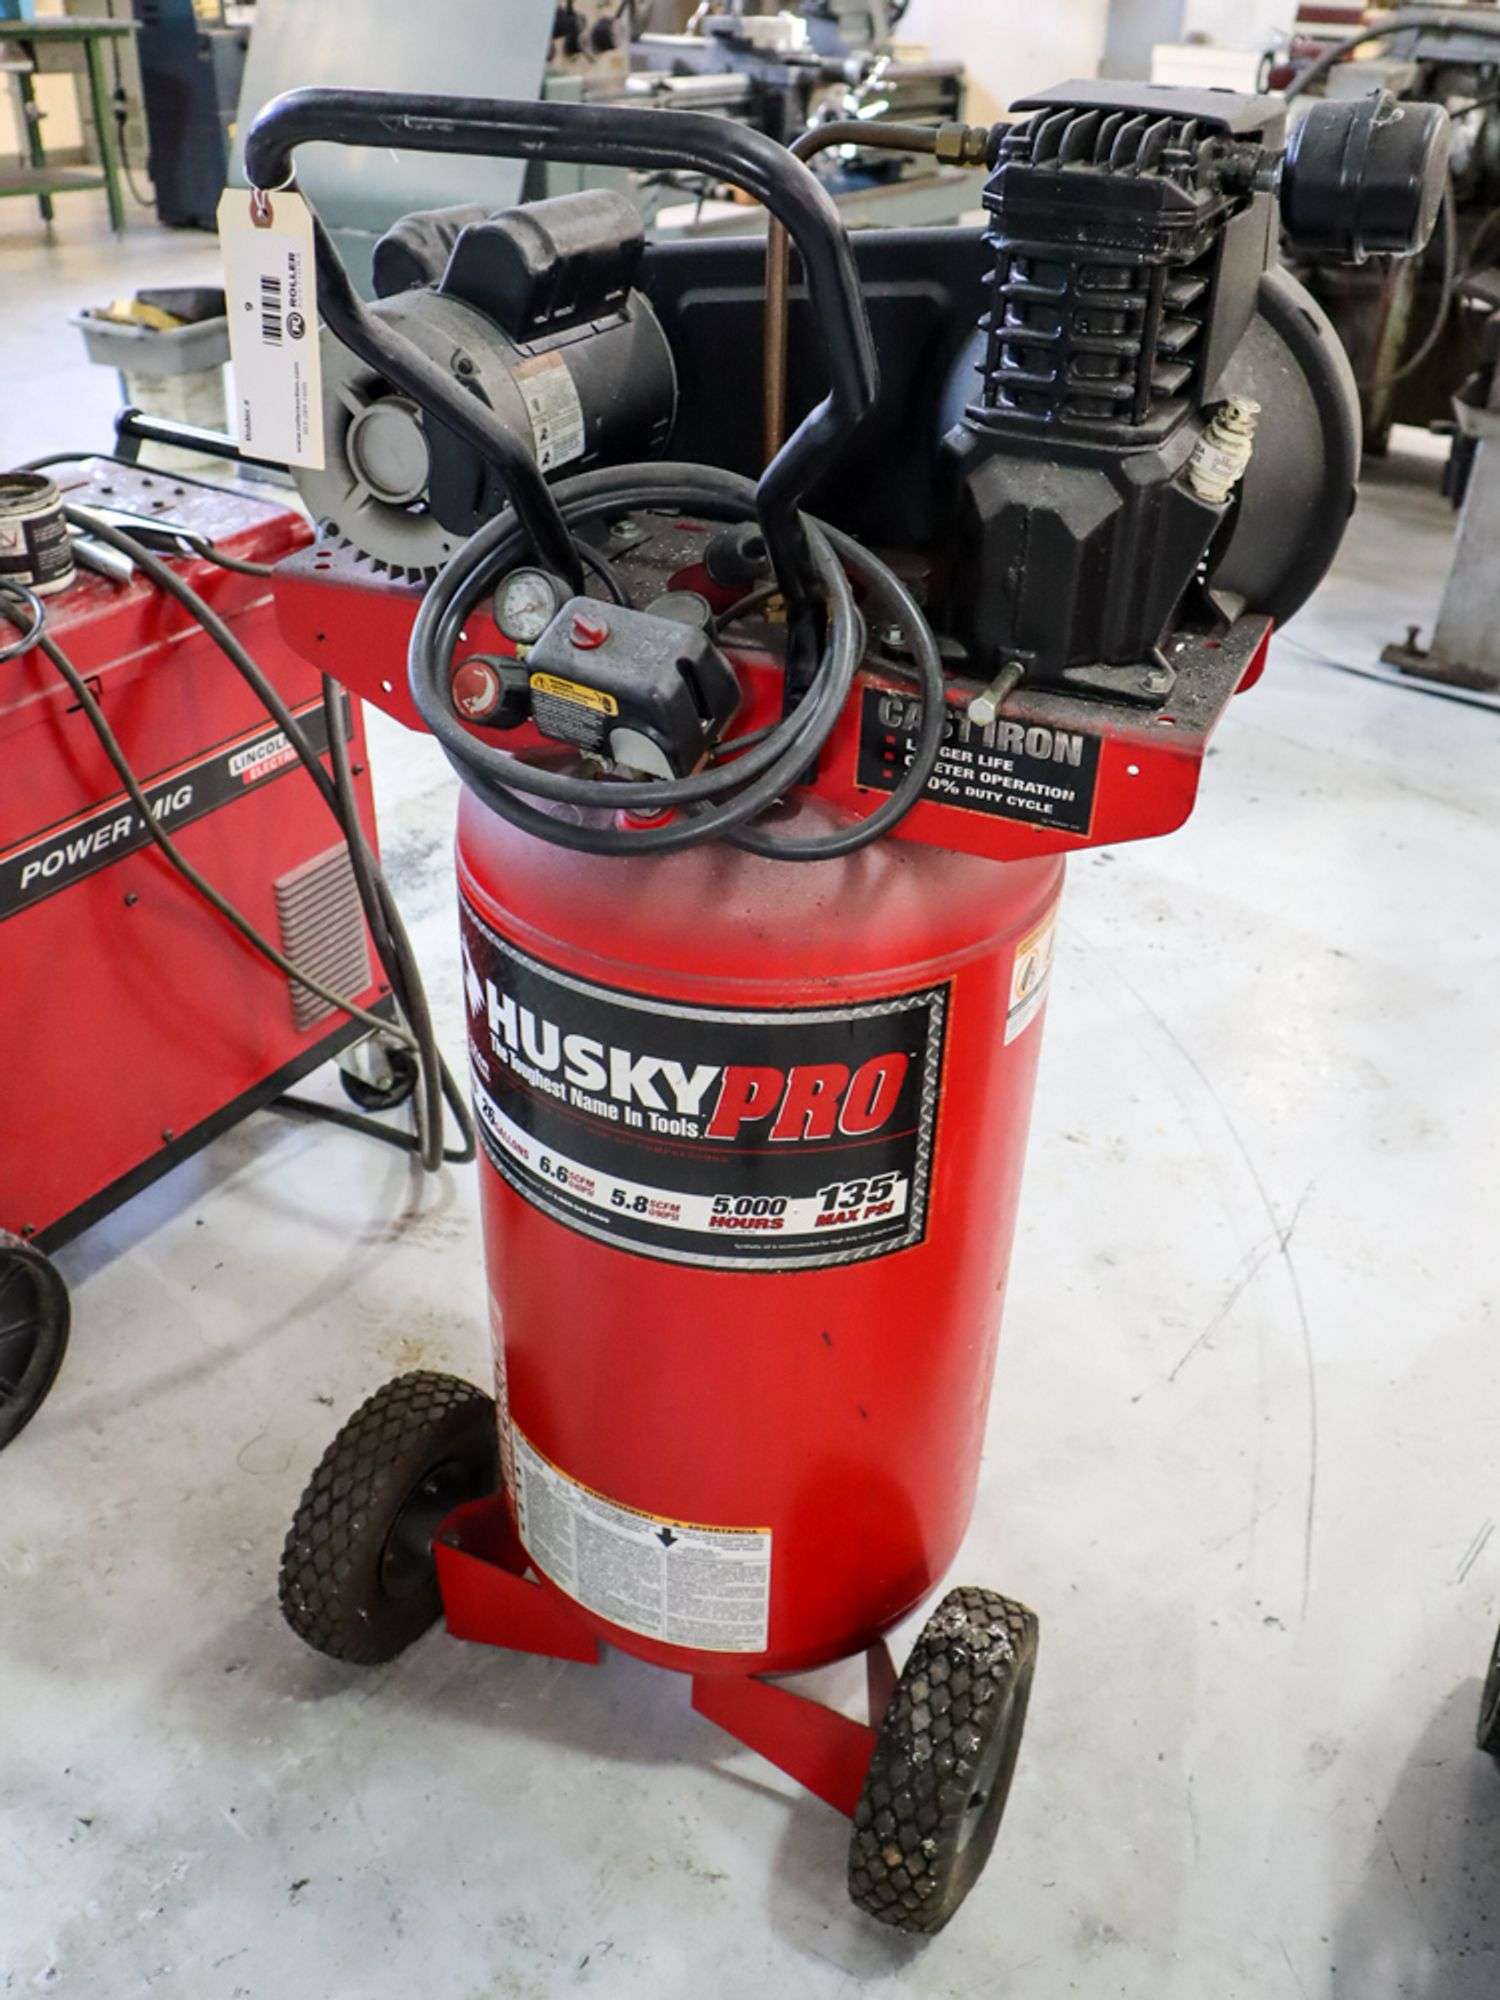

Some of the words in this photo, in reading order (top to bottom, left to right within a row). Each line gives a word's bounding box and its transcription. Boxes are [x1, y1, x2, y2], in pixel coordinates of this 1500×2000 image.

[288, 252, 297, 307] ROLLER
[234, 741, 290, 770] LINCOL
[983, 719, 1083, 767] IRON
[978, 754, 1014, 771] LIFE
[965, 786, 1003, 802] DUTY
[1006, 795, 1054, 814] CYCLE
[980, 772, 1075, 801] OPERATION
[20, 815, 132, 889] POWER
[486, 978, 720, 1116] HUSKY
[704, 1052, 909, 1141] PRO
[570, 1087, 619, 1120] Name
[624, 1106, 643, 1127] In
[540, 1155, 568, 1184] 6.6
[610, 1188, 648, 1213] 5.8
[649, 1200, 681, 1212] SCFM
[820, 1175, 897, 1211] 135
[709, 1216, 784, 1230] HOURS
[815, 1208, 860, 1227] MAX
[863, 1201, 896, 1219] PSI
